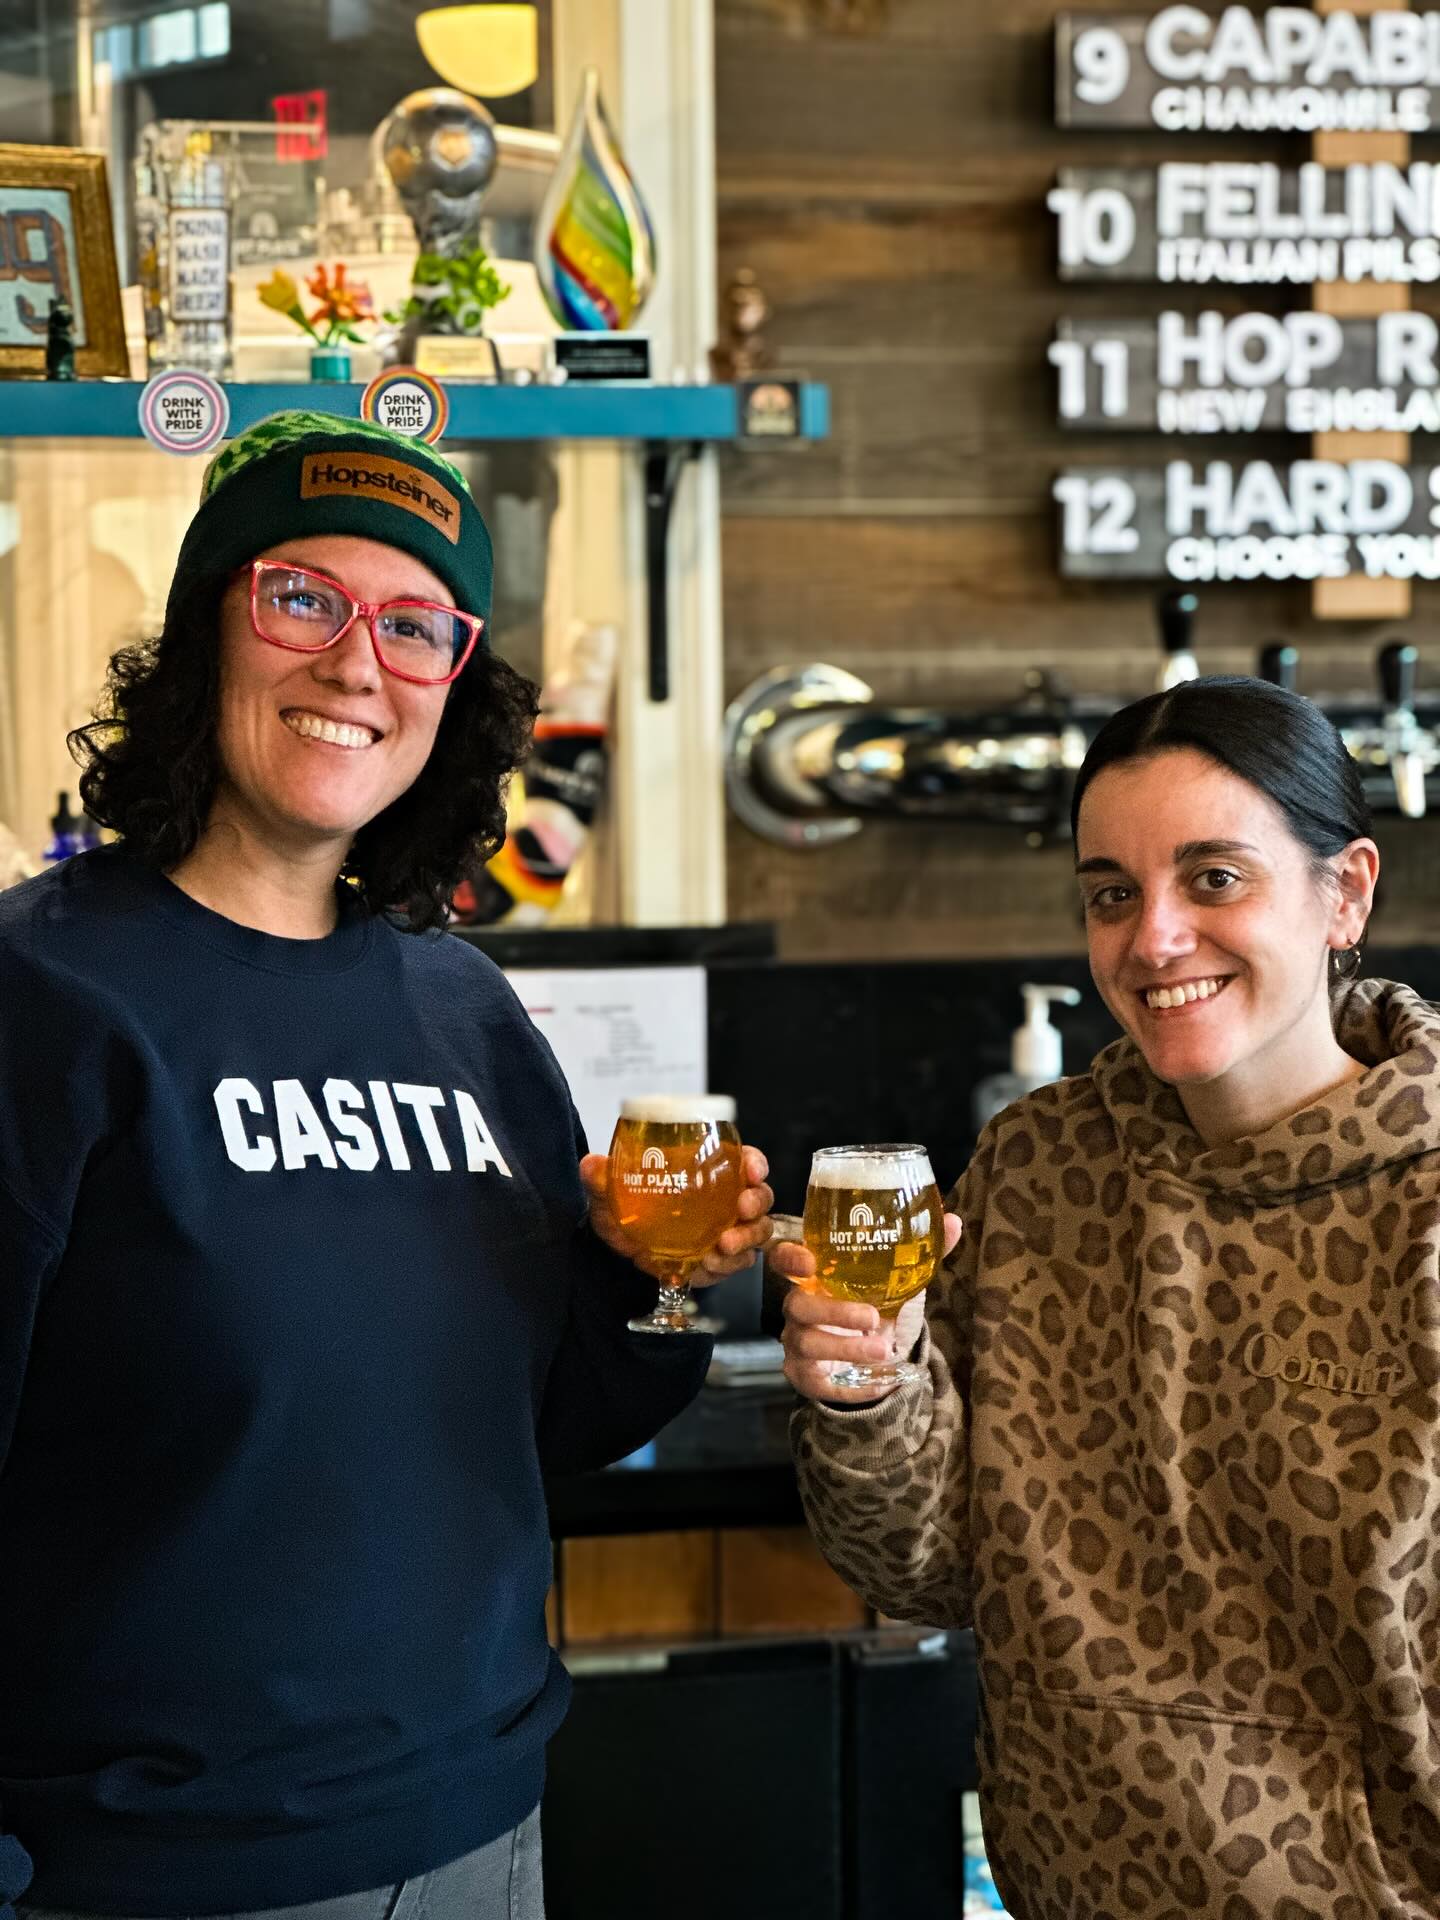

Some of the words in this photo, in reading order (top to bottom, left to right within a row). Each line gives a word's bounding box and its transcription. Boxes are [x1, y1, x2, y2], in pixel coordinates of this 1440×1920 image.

[1073, 27, 1130, 104] 9
[1047, 188, 1136, 266] 10
[1157, 239, 1340, 283] ITALIAN
[1157, 310, 1344, 388] HOP
[384, 395, 426, 405] DRINK
[1047, 340, 1129, 418] 11
[162, 398, 205, 408] DRINK
[165, 420, 203, 430] PRIDE
[166, 409, 200, 419] WITH
[387, 417, 424, 427] PRIDE
[388, 406, 422, 416] WITH
[1157, 388, 1267, 433] NEW
[1285, 387, 1440, 433] ENGLA
[310, 463, 454, 523] Hopsteiner
[1052, 476, 1139, 554] 12
[1165, 459, 1413, 537] HARD
[1165, 534, 1350, 581] CHOOSE
[213, 1077, 513, 1178] CASITA
[623, 1174, 645, 1186] HOT
[647, 1171, 689, 1189] PLATE
[829, 1231, 853, 1244] HOT
[856, 1229, 898, 1243] PLATE
